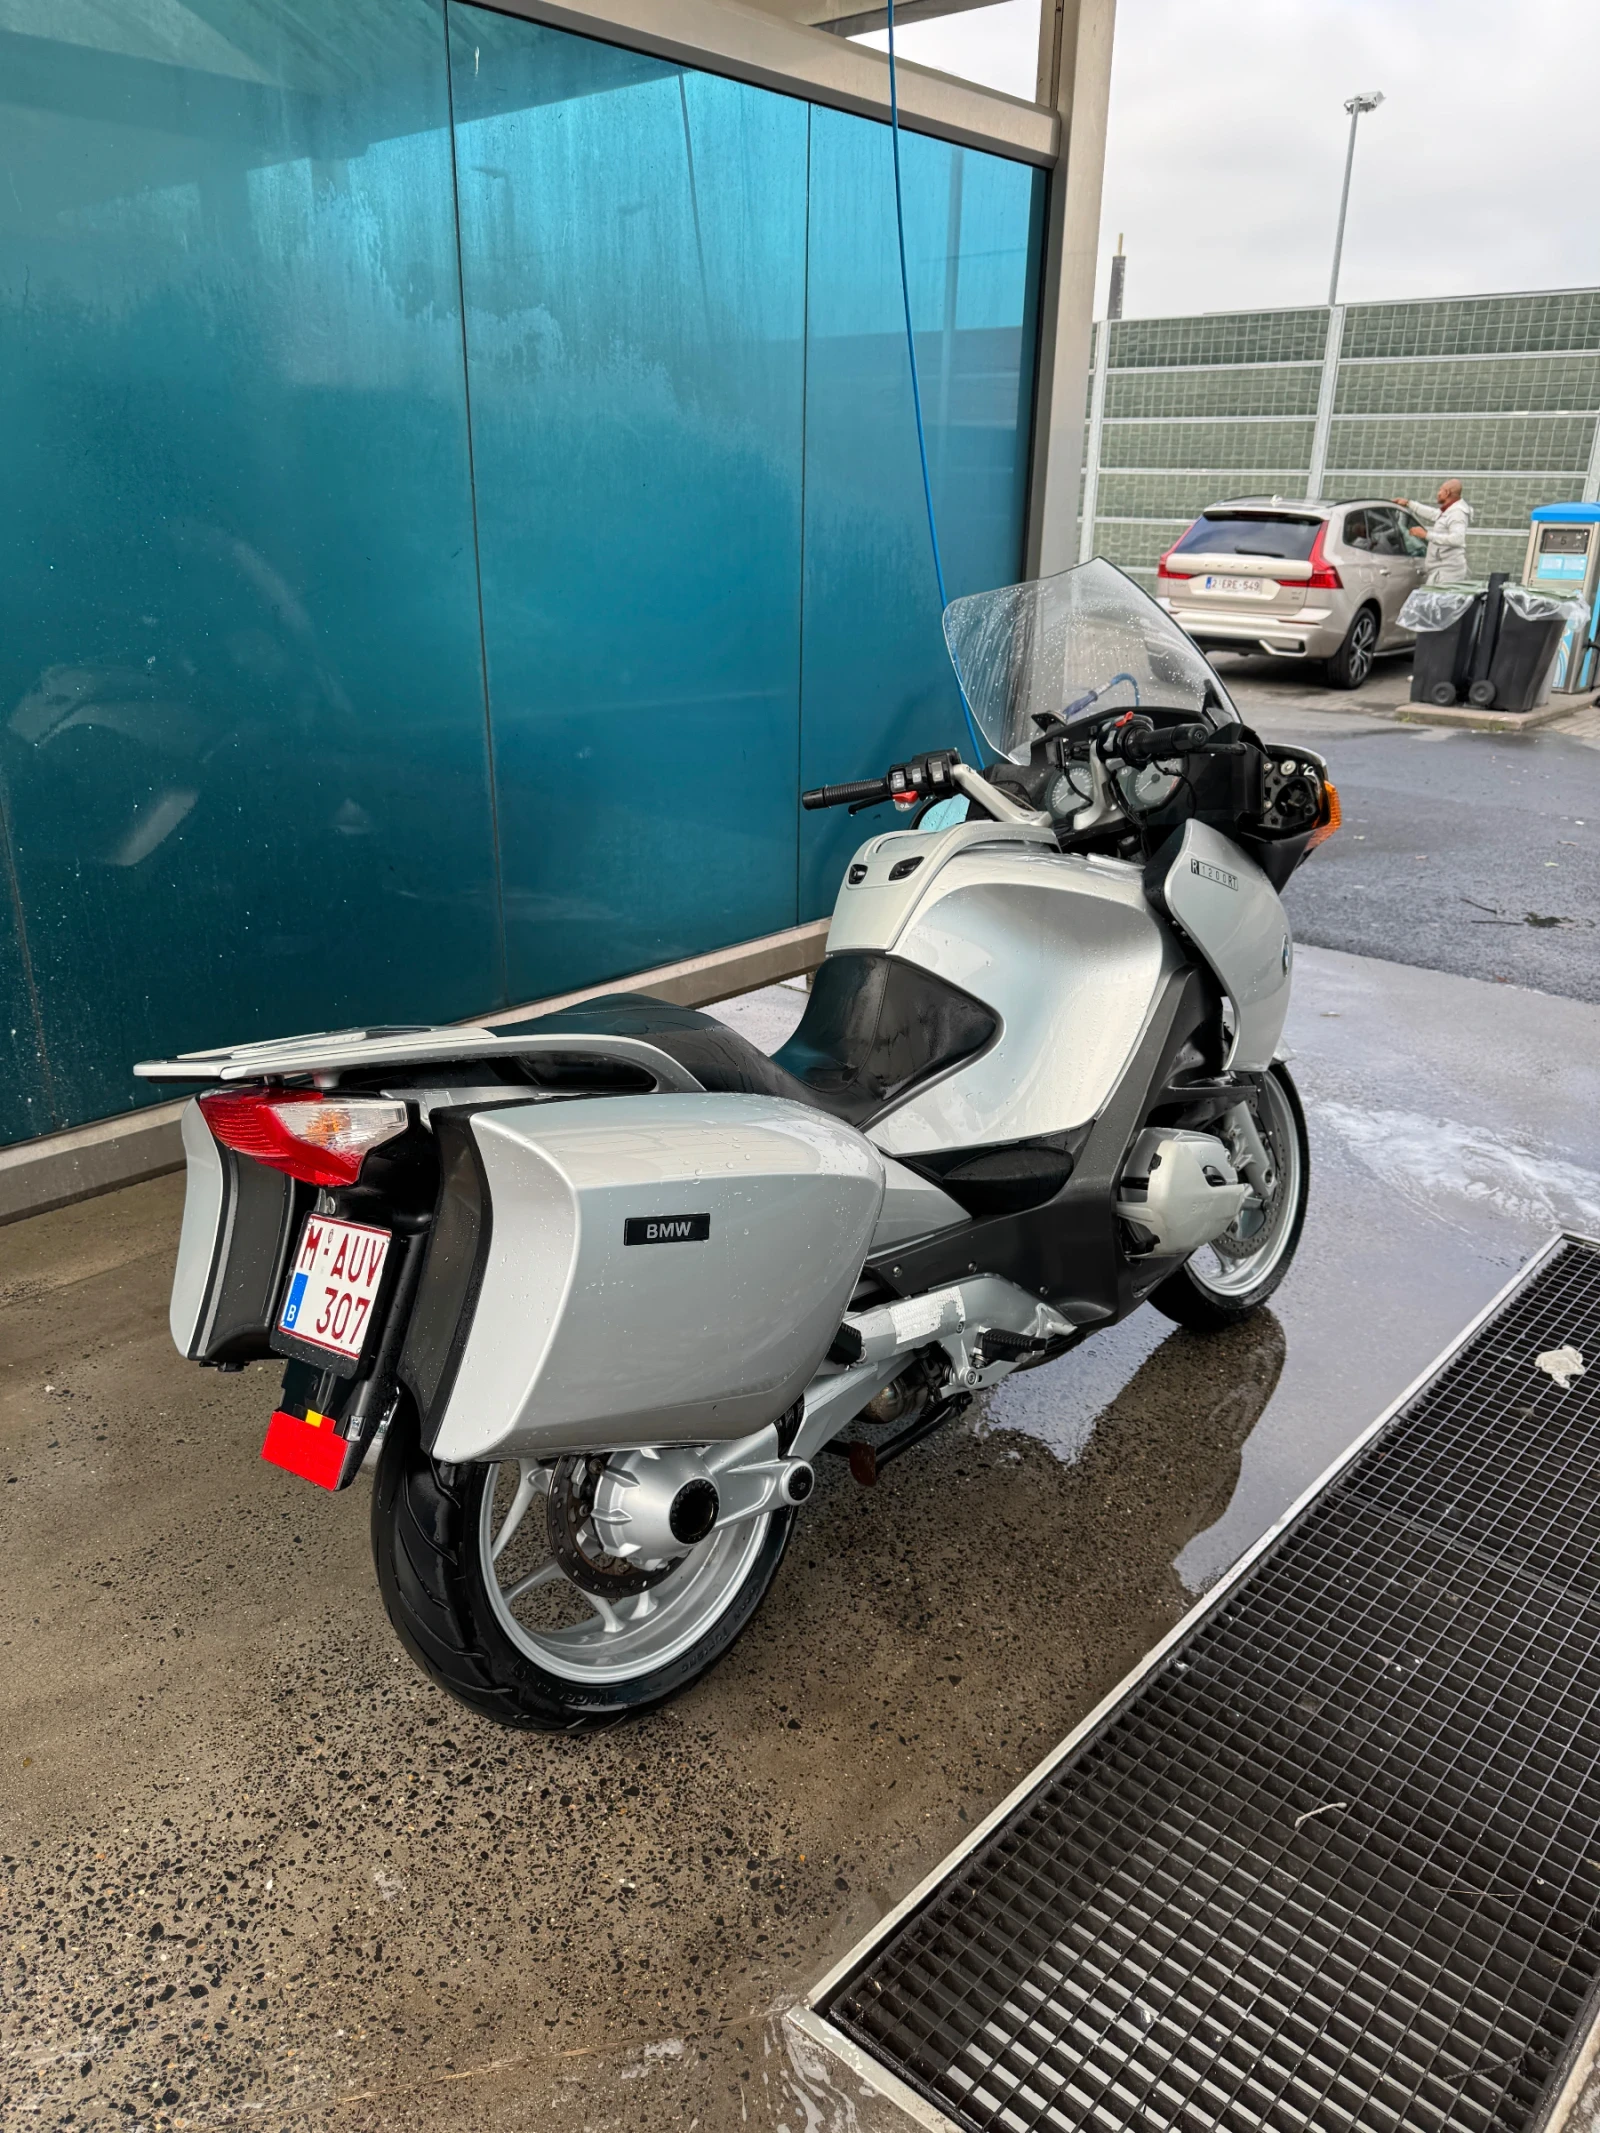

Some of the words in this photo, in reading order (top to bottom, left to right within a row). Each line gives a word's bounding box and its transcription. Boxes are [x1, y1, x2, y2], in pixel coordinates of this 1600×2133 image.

[646, 1221, 692, 1239] BMW
[286, 1304, 297, 1322] B
[315, 1286, 371, 1345] 307
